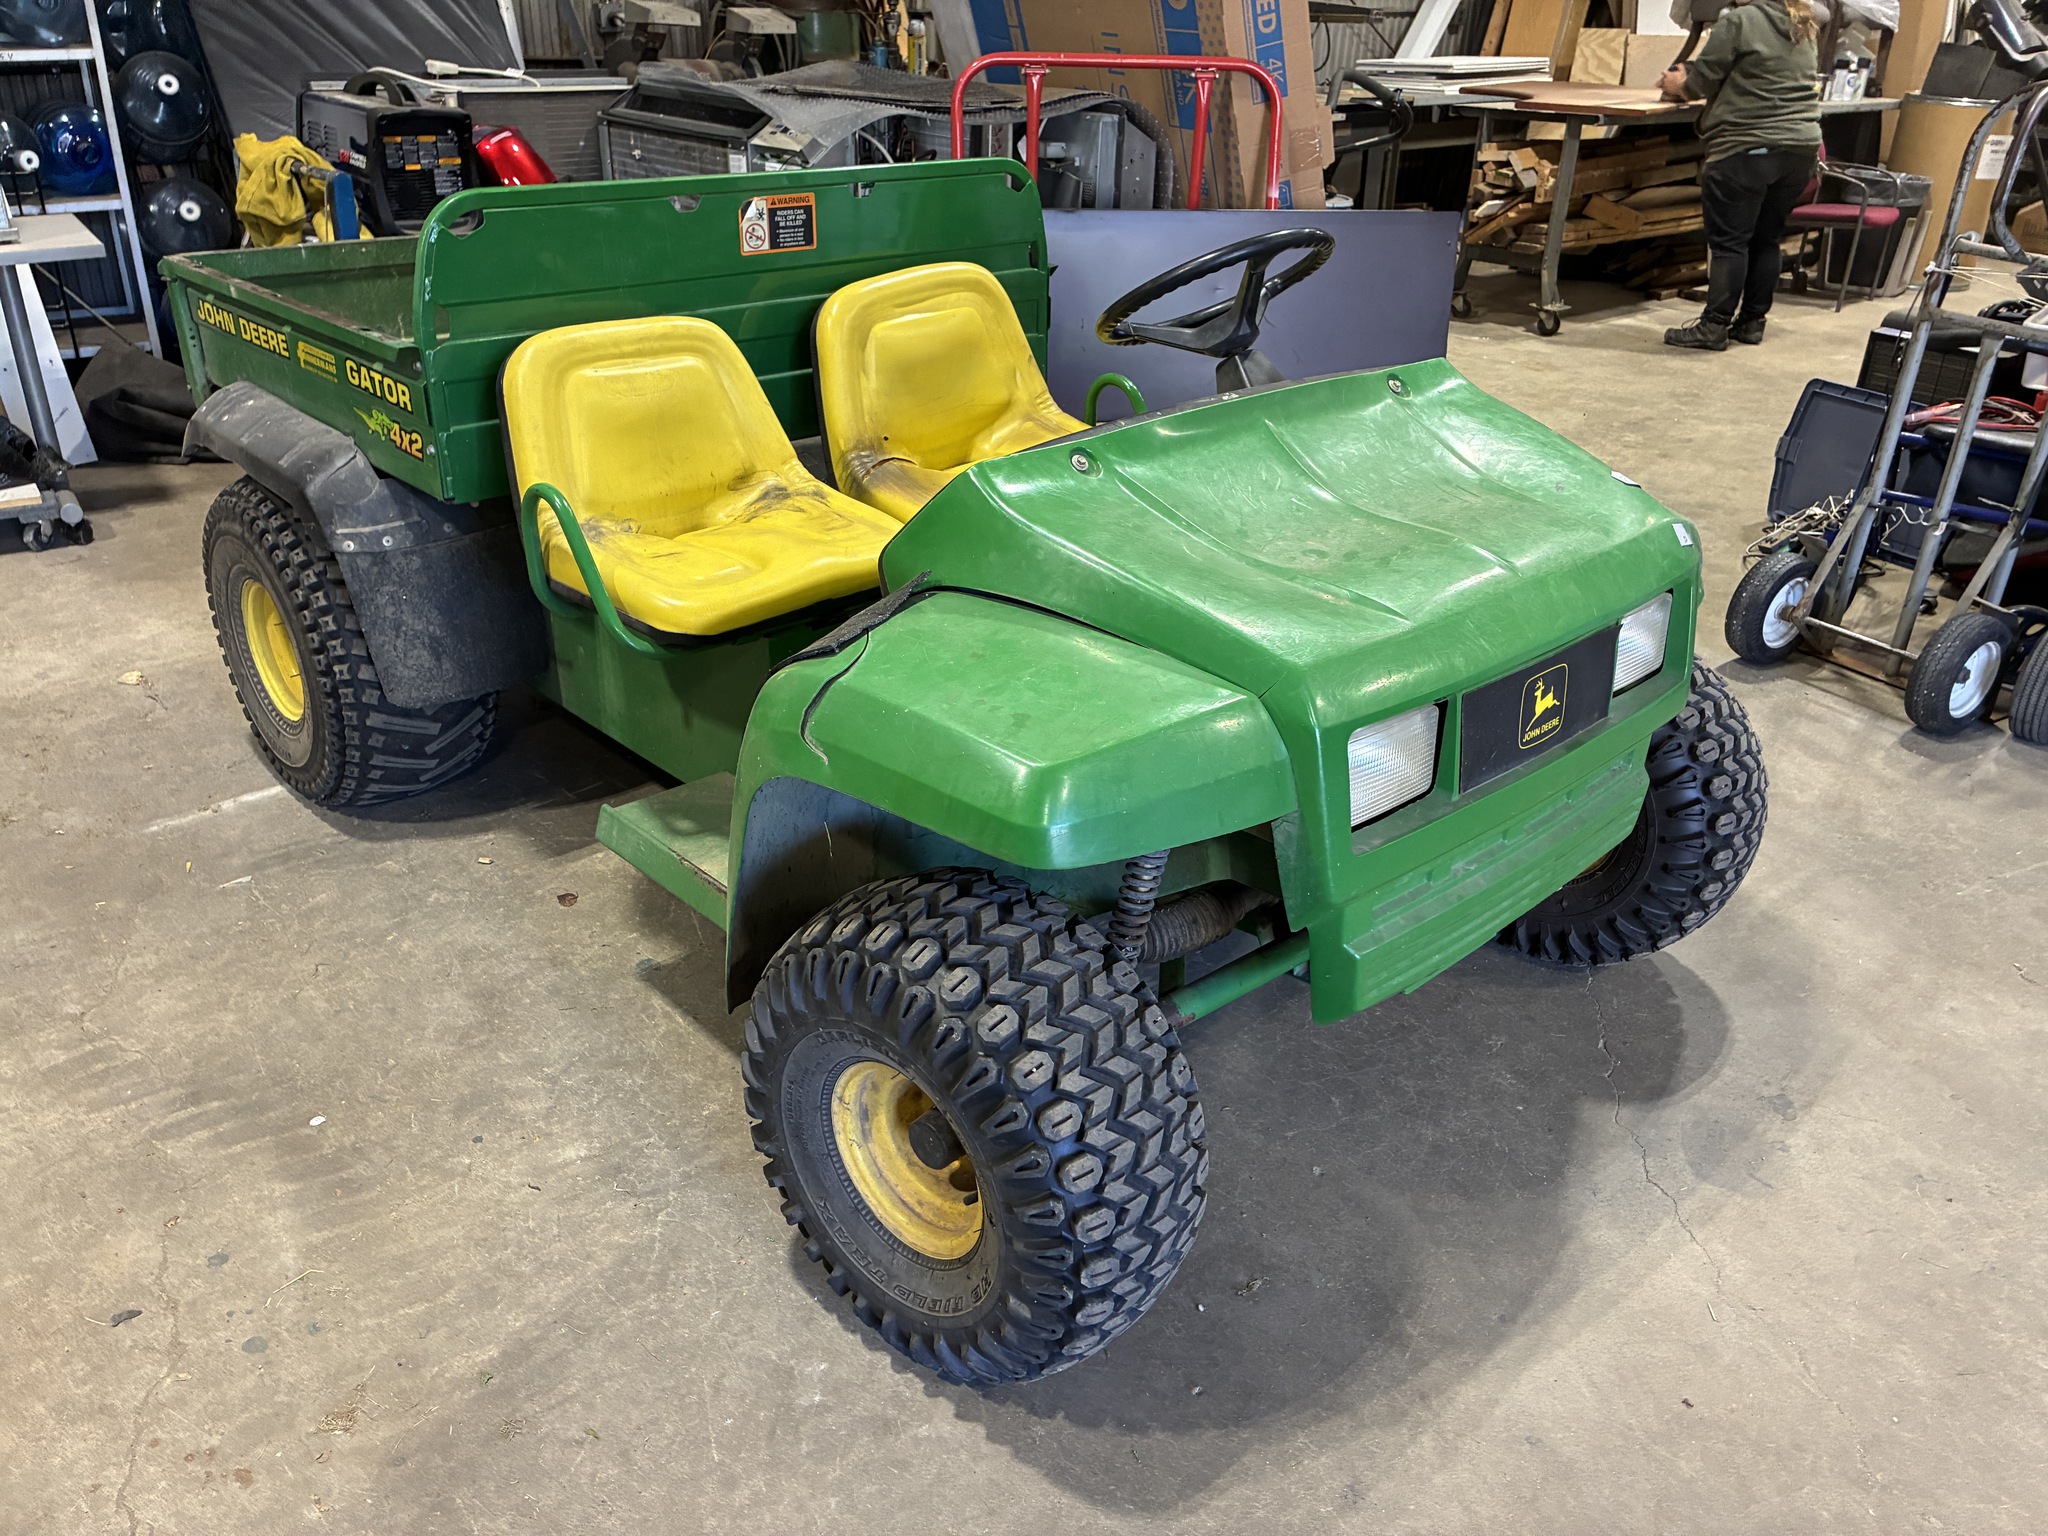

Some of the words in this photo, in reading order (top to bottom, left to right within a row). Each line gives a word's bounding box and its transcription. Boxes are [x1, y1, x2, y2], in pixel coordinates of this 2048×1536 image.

[777, 196, 810, 206] WARNING
[197, 300, 236, 335] JOHN
[238, 317, 290, 358] DEERE
[345, 359, 413, 412] GATOR
[389, 421, 424, 458] 4x2
[1522, 727, 1541, 743] JOHN
[1541, 716, 1560, 734] DEERE
[816, 1196, 887, 1283] TRAX
[892, 1283, 964, 1313] FIELD
